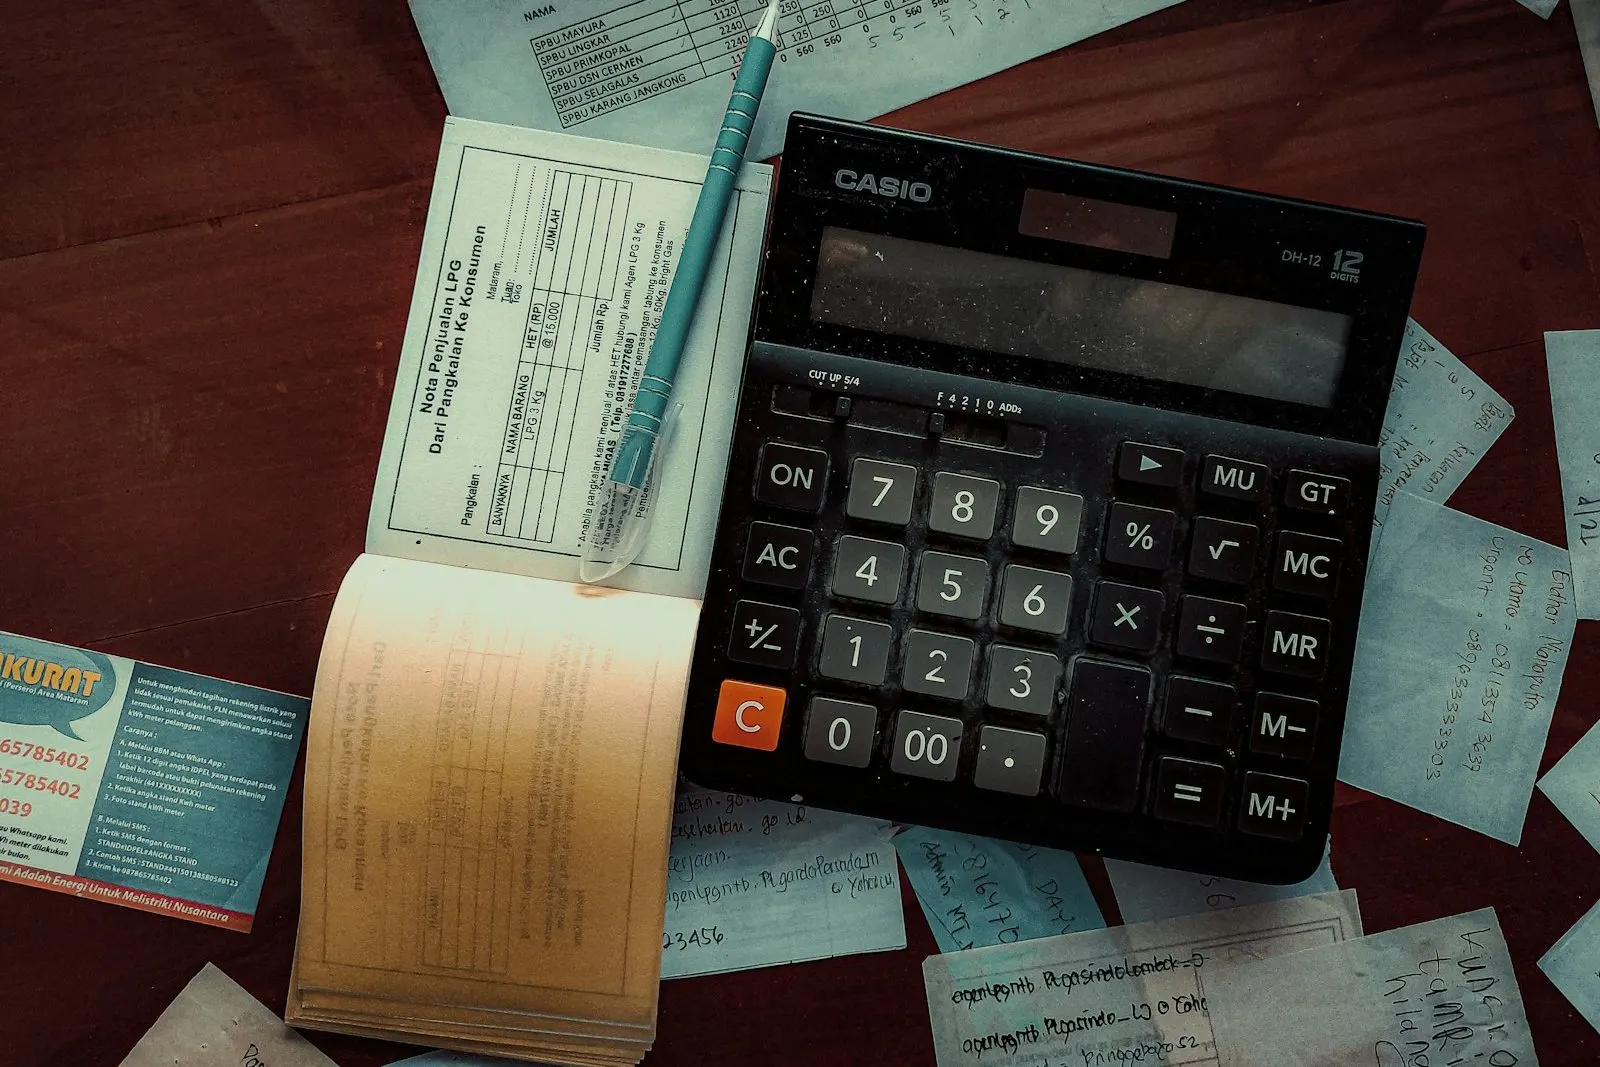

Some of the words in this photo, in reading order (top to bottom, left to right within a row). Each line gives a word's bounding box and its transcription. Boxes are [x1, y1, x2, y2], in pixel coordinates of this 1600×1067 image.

[524, 5, 556, 22] NAMA
[714, 6, 737, 20] 1120
[812, 5, 832, 18] 250
[535, 36, 560, 51] SPBU
[562, 20, 607, 42] MAYURA
[796, 44, 814, 56] 560
[824, 34, 842, 46] 560
[905, 6, 922, 18] 560
[540, 50, 566, 66] SPBU
[568, 34, 611, 57] LINGKAR
[546, 65, 572, 80] SPBU
[574, 44, 632, 71] PRIMKOPAL
[720, 20, 743, 36] 2240
[551, 80, 578, 96] SPBU
[578, 72, 600, 87] DSN
[601, 55, 644, 78] CERMEN
[724, 35, 748, 50] 2240
[557, 95, 583, 110] SPBU
[584, 74, 640, 102] SELAGALAS
[792, 30, 808, 42] 125
[562, 110, 589, 125] SPBU
[590, 93, 632, 116] KARANG
[633, 73, 686, 100] JANGKONG
[835, 169, 931, 202] CASIO
[545, 209, 561, 252] JUMLAH
[634, 222, 646, 234] Kg
[650, 221, 666, 265] konsumen
[628, 244, 640, 263] LPG
[663, 240, 674, 258] Gas
[1282, 249, 1322, 266] DH-12
[1333, 248, 1364, 275] 12
[445, 260, 461, 292] LPG
[459, 226, 486, 307] Konsumen
[624, 265, 636, 288] Agen
[649, 266, 658, 277] ke
[658, 260, 671, 286] Bright
[1330, 272, 1360, 284] DIGITS
[643, 279, 658, 308] tabung
[454, 312, 469, 332] Ke
[531, 303, 545, 325] (RP)
[544, 302, 560, 335] 15.000
[428, 297, 455, 373] Penjualan
[525, 327, 538, 349] HET
[590, 319, 604, 353] Jumlah
[635, 311, 651, 366] pemasangan
[610, 348, 621, 367] HET
[436, 337, 464, 417] Pangkalan
[608, 370, 618, 388] atas
[629, 367, 640, 398] antar
[809, 369, 827, 381] CUT
[829, 374, 842, 384] UP
[844, 376, 860, 386] 5/4
[419, 378, 438, 413] Nota
[512, 375, 529, 420] BARANG
[530, 388, 546, 406] Kg
[605, 390, 614, 398] di
[938, 392, 944, 400] F
[949, 394, 956, 403] 4
[962, 396, 969, 405] 2
[975, 398, 980, 408] 1
[987, 400, 994, 410] 0
[429, 422, 446, 454] Dari
[505, 422, 521, 454] NAMA
[524, 417, 538, 440] LPG
[594, 437, 605, 458] kami
[587, 460, 603, 506] pangkalan
[460, 474, 480, 526] Pangkalan
[492, 474, 510, 526] BANYAKNYA
[770, 464, 814, 490] ON
[872, 476, 894, 506] 7
[952, 490, 974, 522] 8
[1036, 505, 1058, 536] 9
[1214, 466, 1255, 490] MU
[1300, 481, 1335, 504] GT
[756, 543, 798, 570] AC
[855, 556, 878, 586] 4
[939, 570, 963, 601] 5
[1023, 585, 1046, 616] 6
[1283, 551, 1330, 578] MC
[0, 652, 101, 697] KURAT
[848, 636, 862, 666] 1
[925, 650, 947, 682] 2
[1010, 666, 1032, 698] 3
[1272, 632, 1317, 660] MR
[4, 681, 37, 695] (Persero)
[37, 689, 54, 698] Area
[56, 692, 89, 706] Mataram
[137, 677, 158, 687] Untuk
[279, 710, 296, 719] yang
[735, 701, 765, 732] C
[828, 718, 851, 750] 0
[905, 730, 948, 765] 00
[1248, 793, 1295, 820] M+
[8, 840, 32, 848] meter
[32, 843, 69, 857] dilakukan
[10, 826, 47, 841] Whatsapp
[7, 850, 30, 861] bulan.
[14, 869, 52, 884] Adalah
[52, 877, 87, 892] Energi
[89, 884, 122, 898] Untuk
[122, 891, 173, 909] Melistriki
[174, 904, 229, 922] Nusantara
